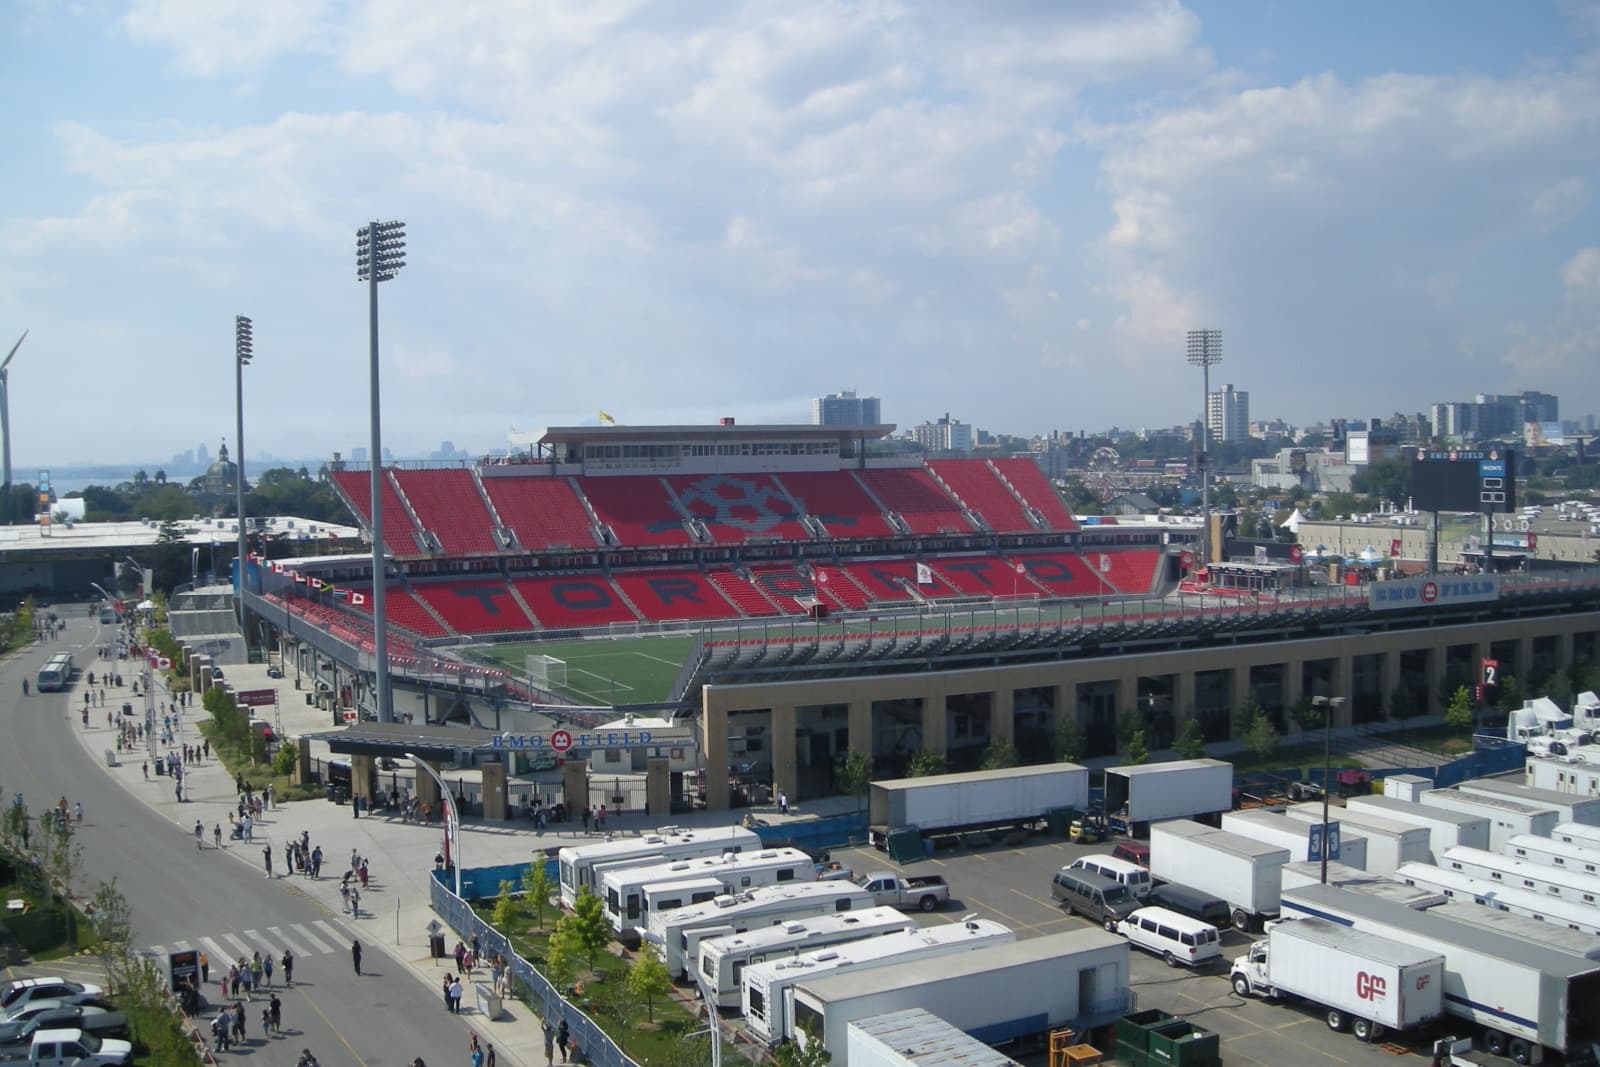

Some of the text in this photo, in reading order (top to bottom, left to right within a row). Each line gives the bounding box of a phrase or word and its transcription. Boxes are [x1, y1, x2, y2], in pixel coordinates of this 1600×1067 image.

[1441, 582, 1494, 597] FIELD
[1486, 666, 1495, 684] 2
[492, 732, 653, 748] BMO FIELD
[1311, 833, 1320, 853] 3
[1330, 831, 1338, 851] 3
